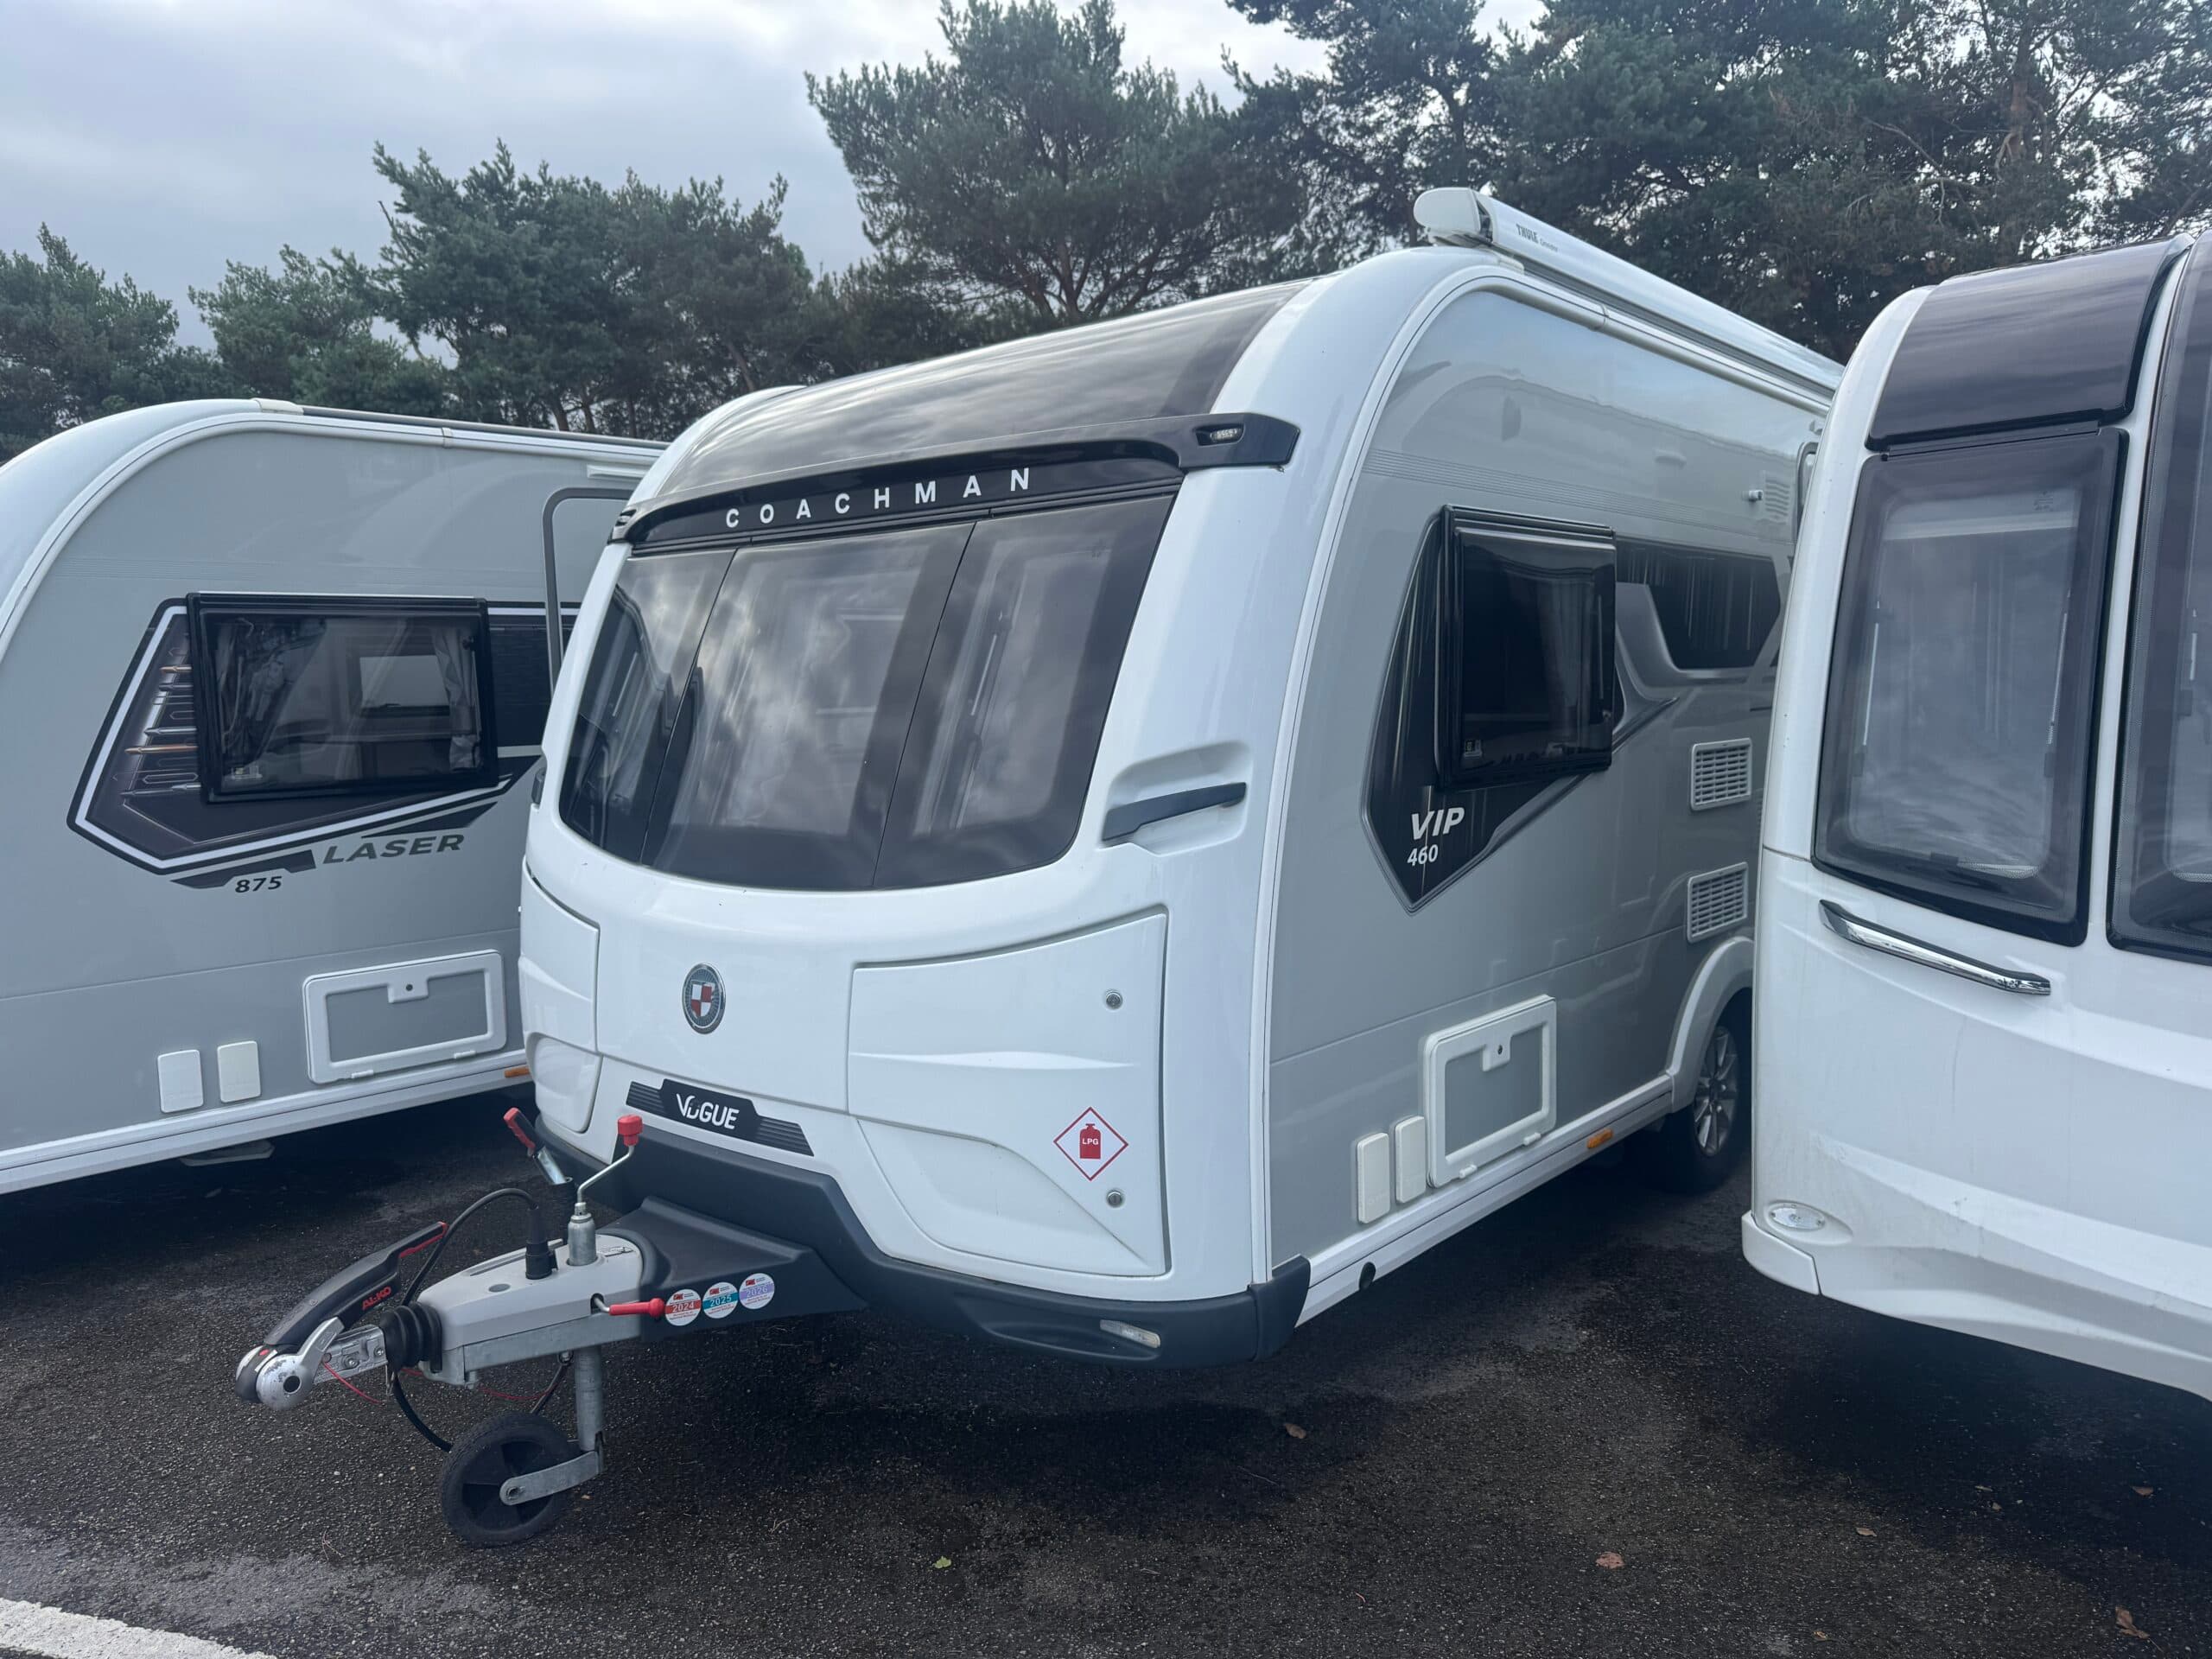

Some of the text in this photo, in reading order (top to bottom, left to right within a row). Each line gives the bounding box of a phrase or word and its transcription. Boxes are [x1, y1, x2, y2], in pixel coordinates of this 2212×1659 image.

[1516, 223, 1538, 244] THULE
[725, 467, 1030, 528] COACHMAN
[1411, 806, 1465, 840] VIP
[322, 834, 465, 864] LASER
[1407, 843, 1439, 867] 460
[234, 875, 283, 893] 875
[709, 1295, 732, 1307] 2025
[746, 1285, 768, 1298] 2026
[672, 1301, 695, 1313] 2024
